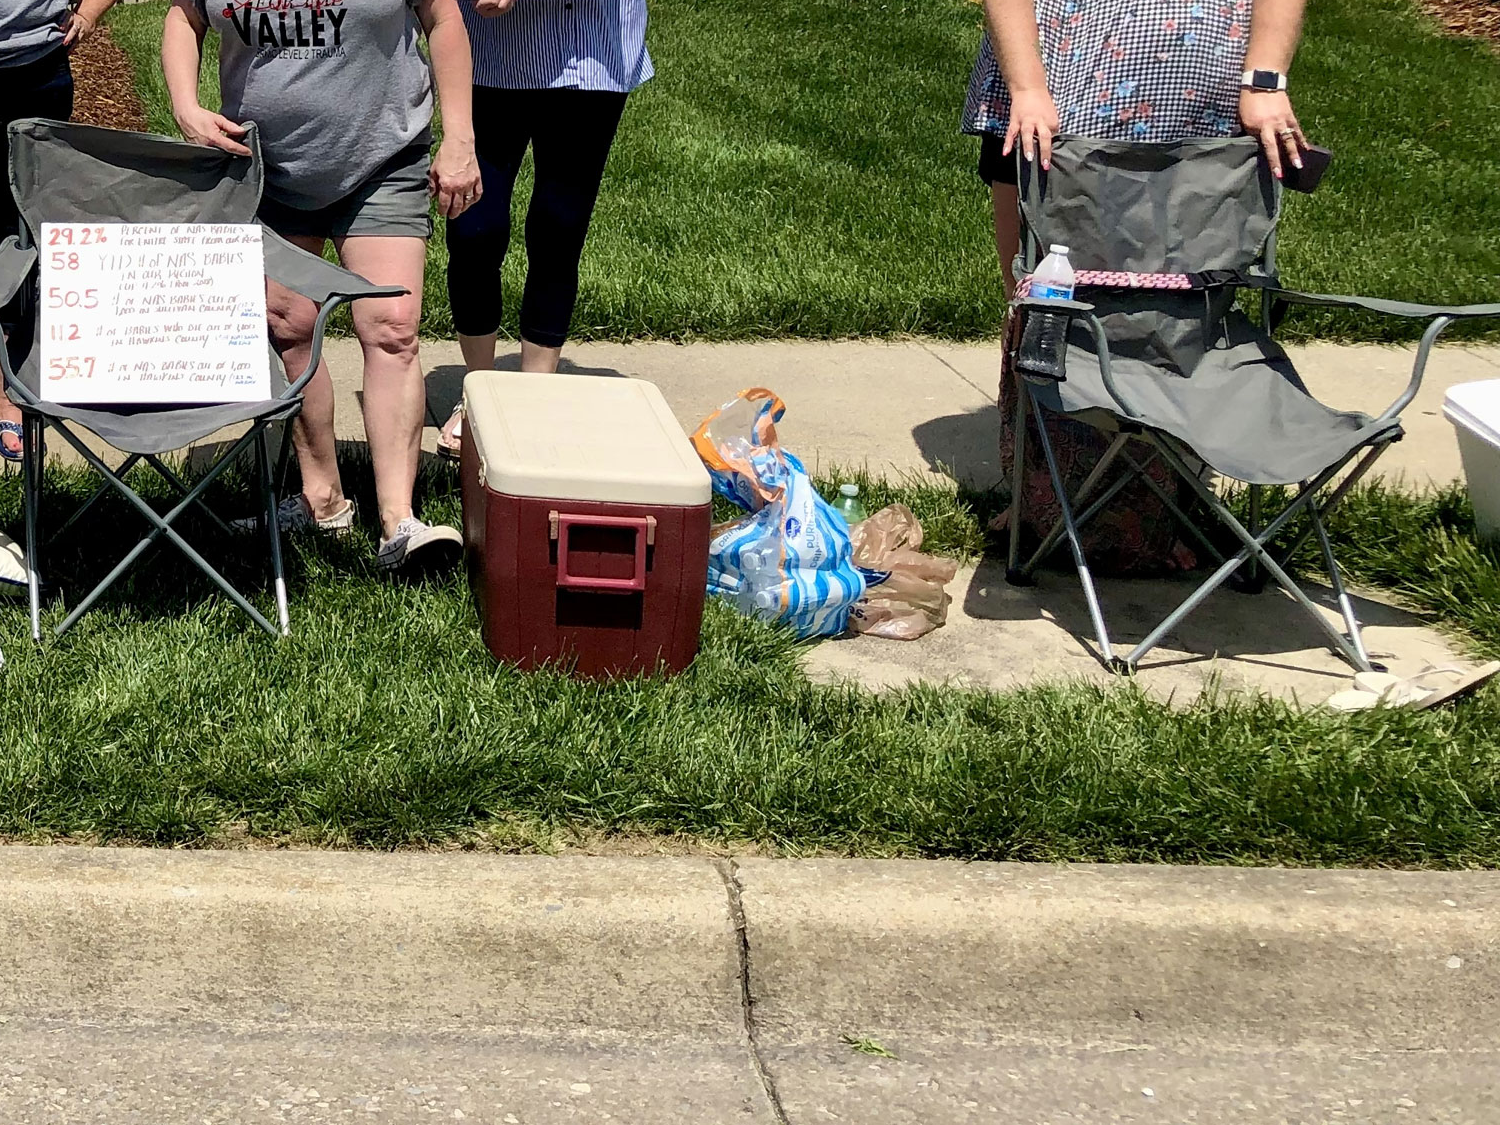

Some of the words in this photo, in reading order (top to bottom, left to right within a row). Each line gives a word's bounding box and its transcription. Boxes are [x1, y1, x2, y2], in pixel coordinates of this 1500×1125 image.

[227, 1, 348, 48] VALLEY
[279, 48, 302, 59] LEVEL
[304, 49, 309, 59] 2
[311, 47, 347, 58] TRAUMA
[48, 227, 107, 246] 29.2%
[51, 252, 80, 270] 58
[48, 287, 99, 309] 50.5
[48, 356, 96, 381] 55.7
